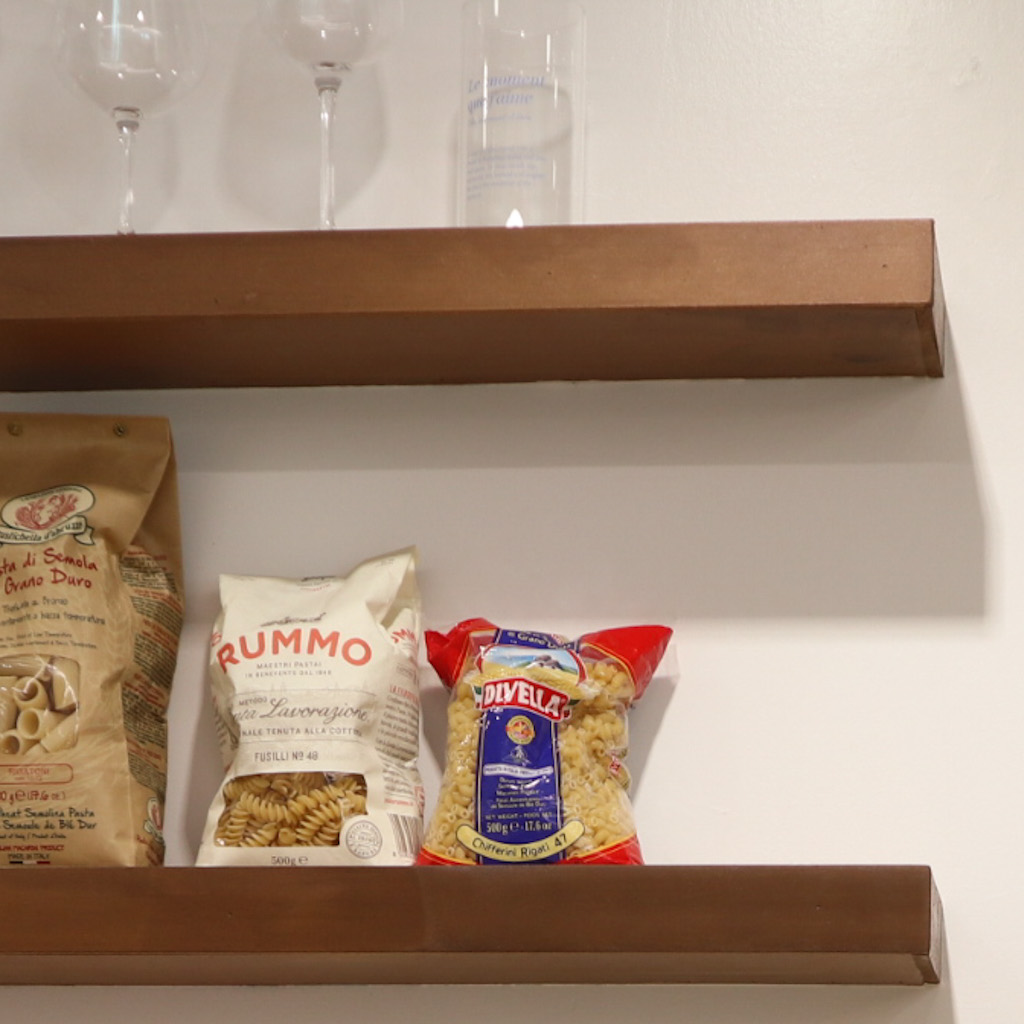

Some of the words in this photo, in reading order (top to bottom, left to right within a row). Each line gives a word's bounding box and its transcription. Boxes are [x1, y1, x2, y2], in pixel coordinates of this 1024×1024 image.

[43, 547, 98, 571] Semola
[5, 576, 43, 595] Grano
[50, 568, 92, 588] Duro
[216, 627, 373, 675] RUMMO
[484, 680, 562, 718] DIVELLA
[259, 697, 369, 725] Lavorazione
[254, 751, 290, 763] FUSILLI
[68, 806, 95, 817] Pasta
[486, 821, 509, 836] 500g
[520, 843, 549, 858] Rigati
[271, 855, 297, 867] 500g
